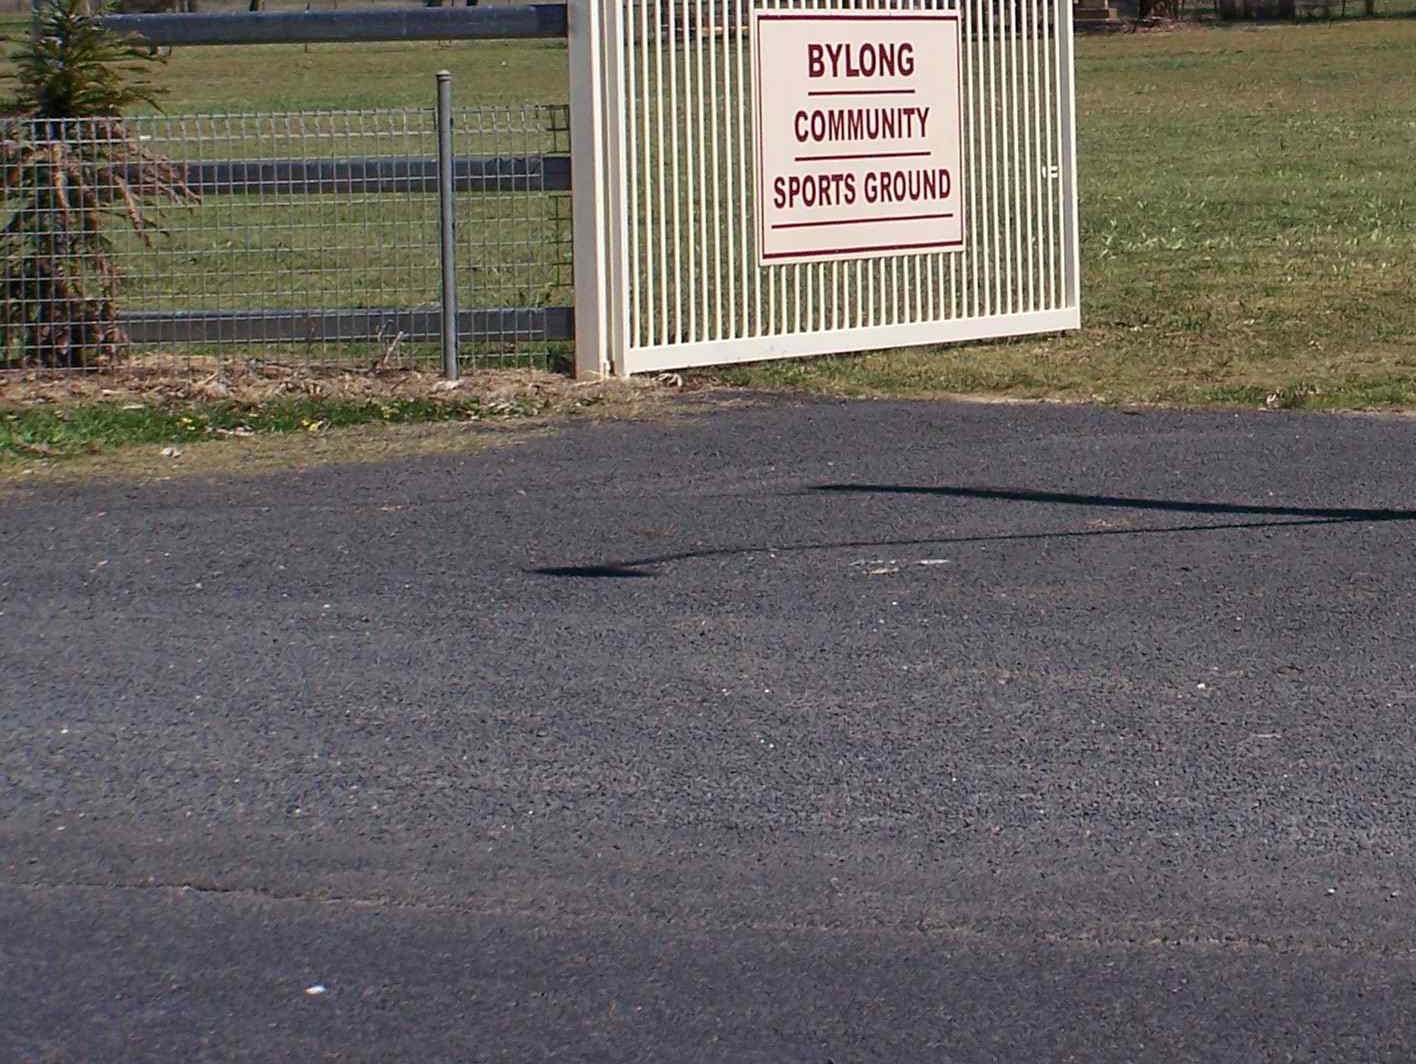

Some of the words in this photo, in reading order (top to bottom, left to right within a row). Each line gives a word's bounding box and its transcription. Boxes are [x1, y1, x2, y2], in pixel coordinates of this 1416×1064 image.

[808, 42, 915, 78] BYLONG
[794, 107, 930, 142] COMMUNITY
[773, 173, 856, 209] SPORTS
[864, 168, 951, 204] GROUND
